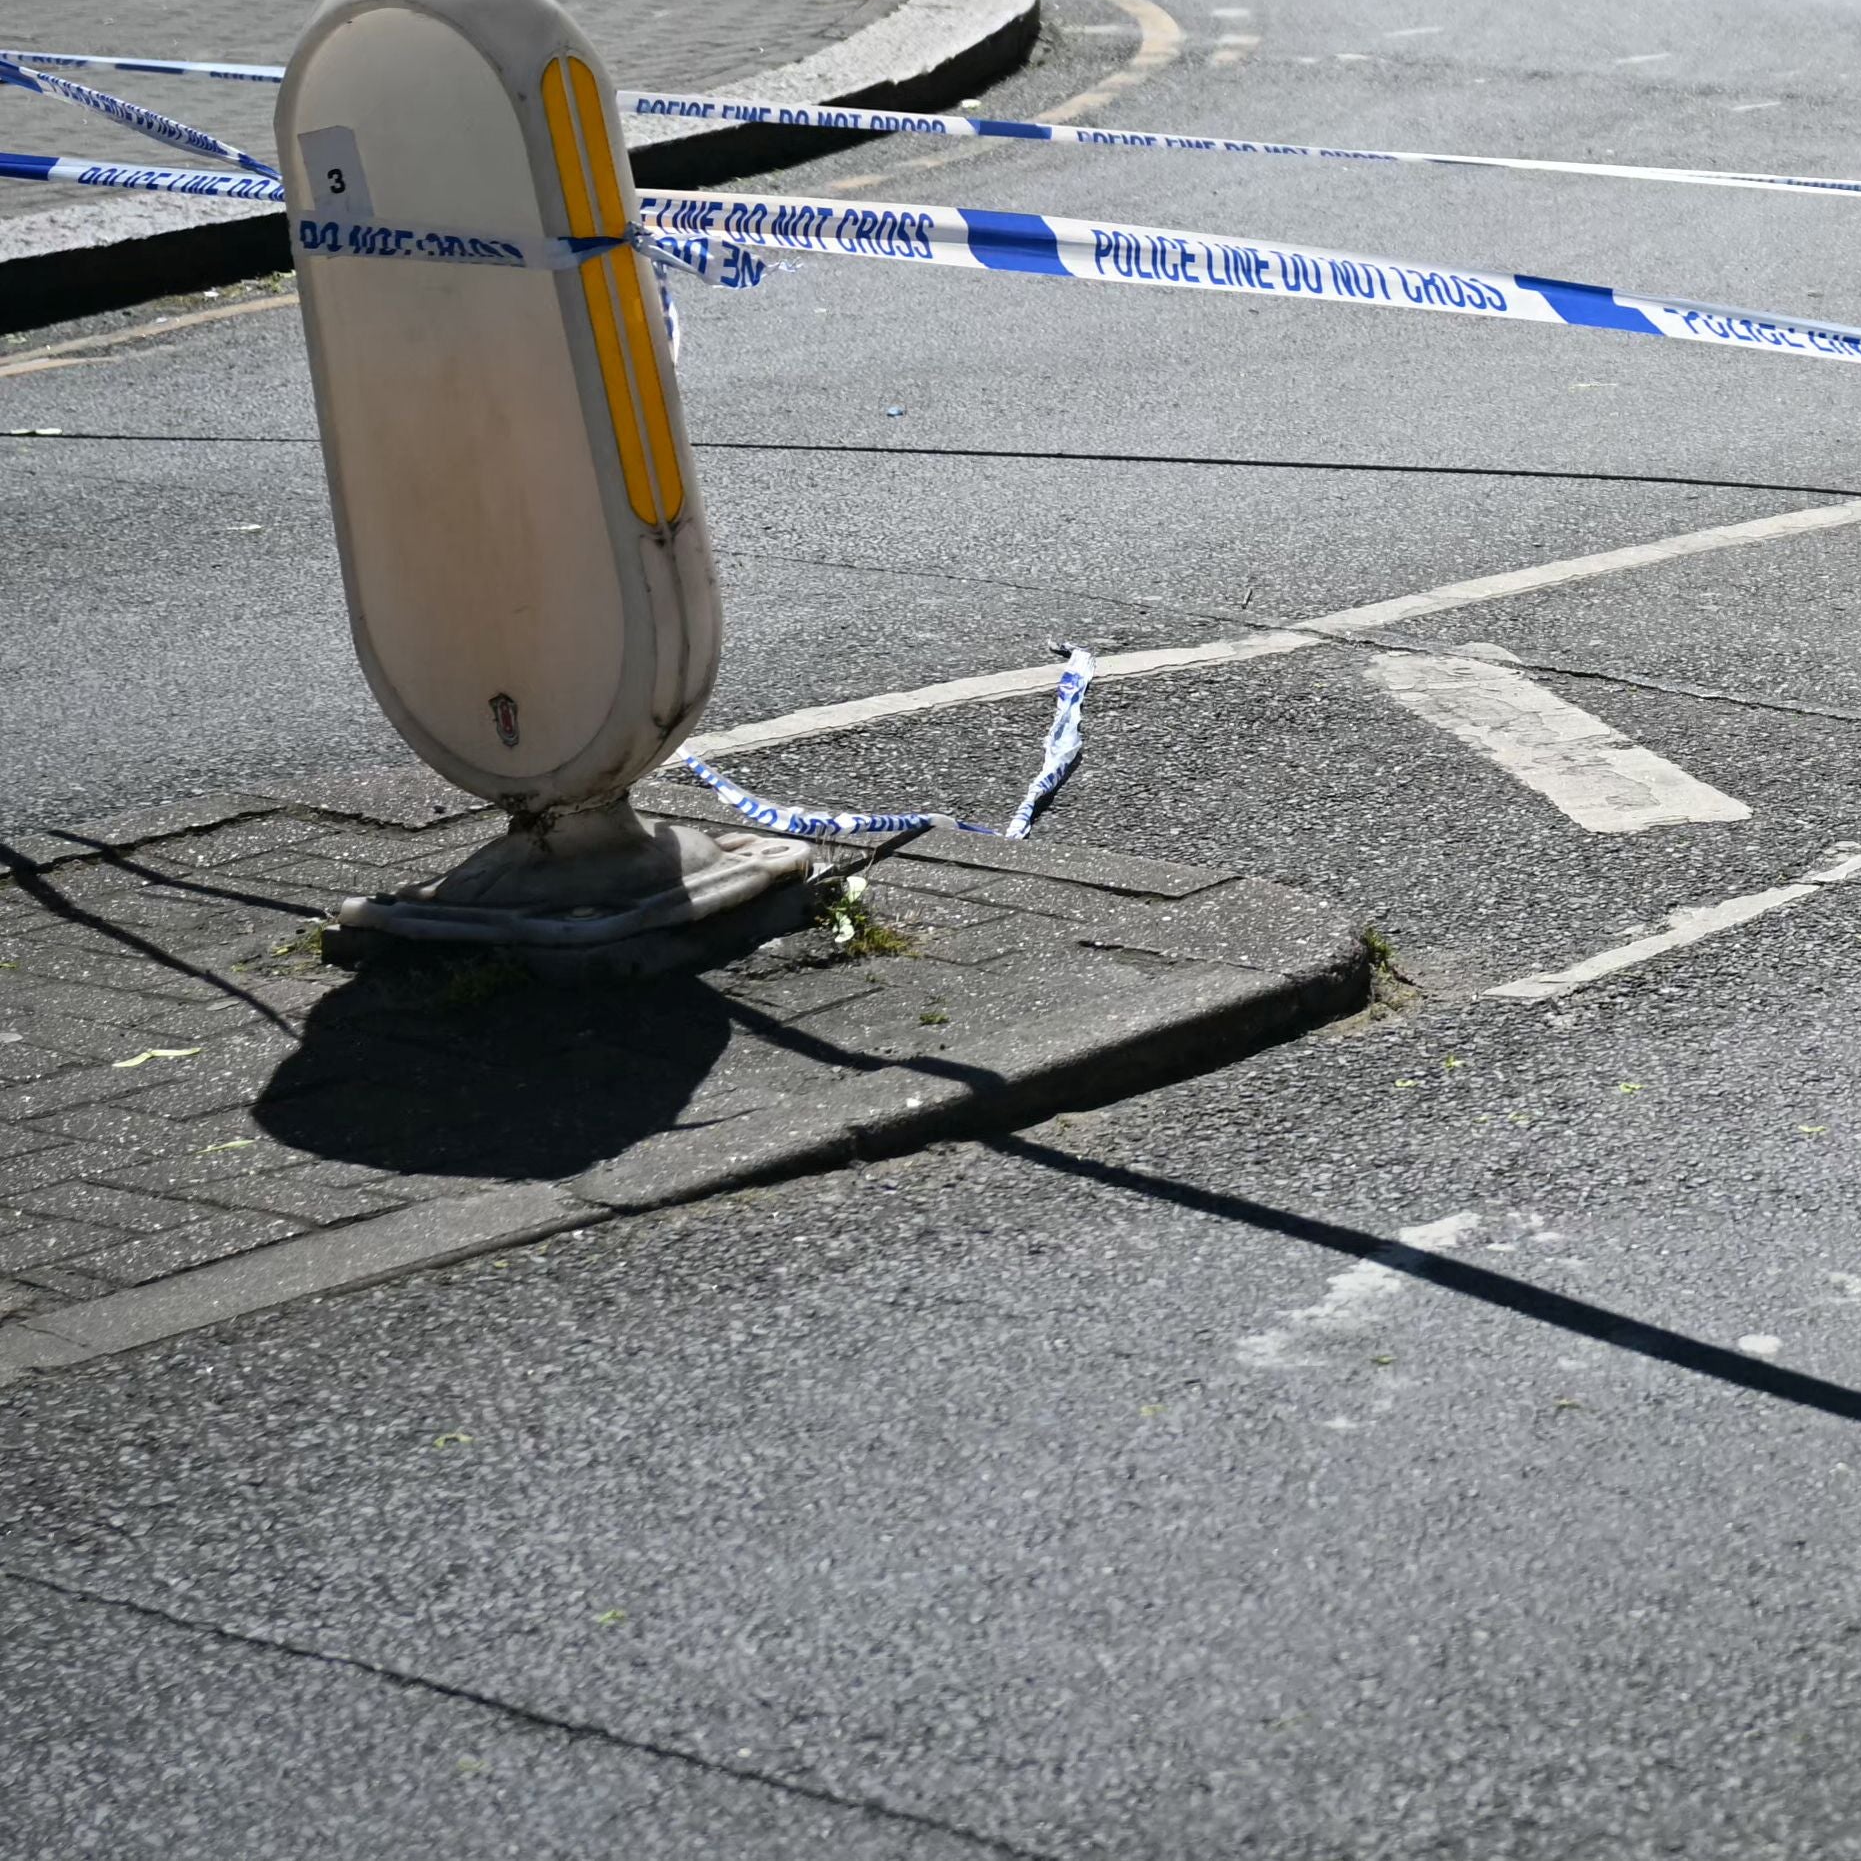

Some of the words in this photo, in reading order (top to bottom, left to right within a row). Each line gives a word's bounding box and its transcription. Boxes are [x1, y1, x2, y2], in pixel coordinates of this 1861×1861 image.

[326, 168, 346, 194] 3
[655, 198, 723, 236] LINE
[724, 202, 768, 245] DO
[771, 204, 834, 251] NOT
[836, 206, 935, 260] CROSS
[1091, 229, 1200, 283] POLICE
[1199, 241, 1275, 290] LINE
[1271, 250, 1323, 294] DO
[1321, 257, 1392, 300] NOT
[1390, 266, 1507, 312] CROSS
